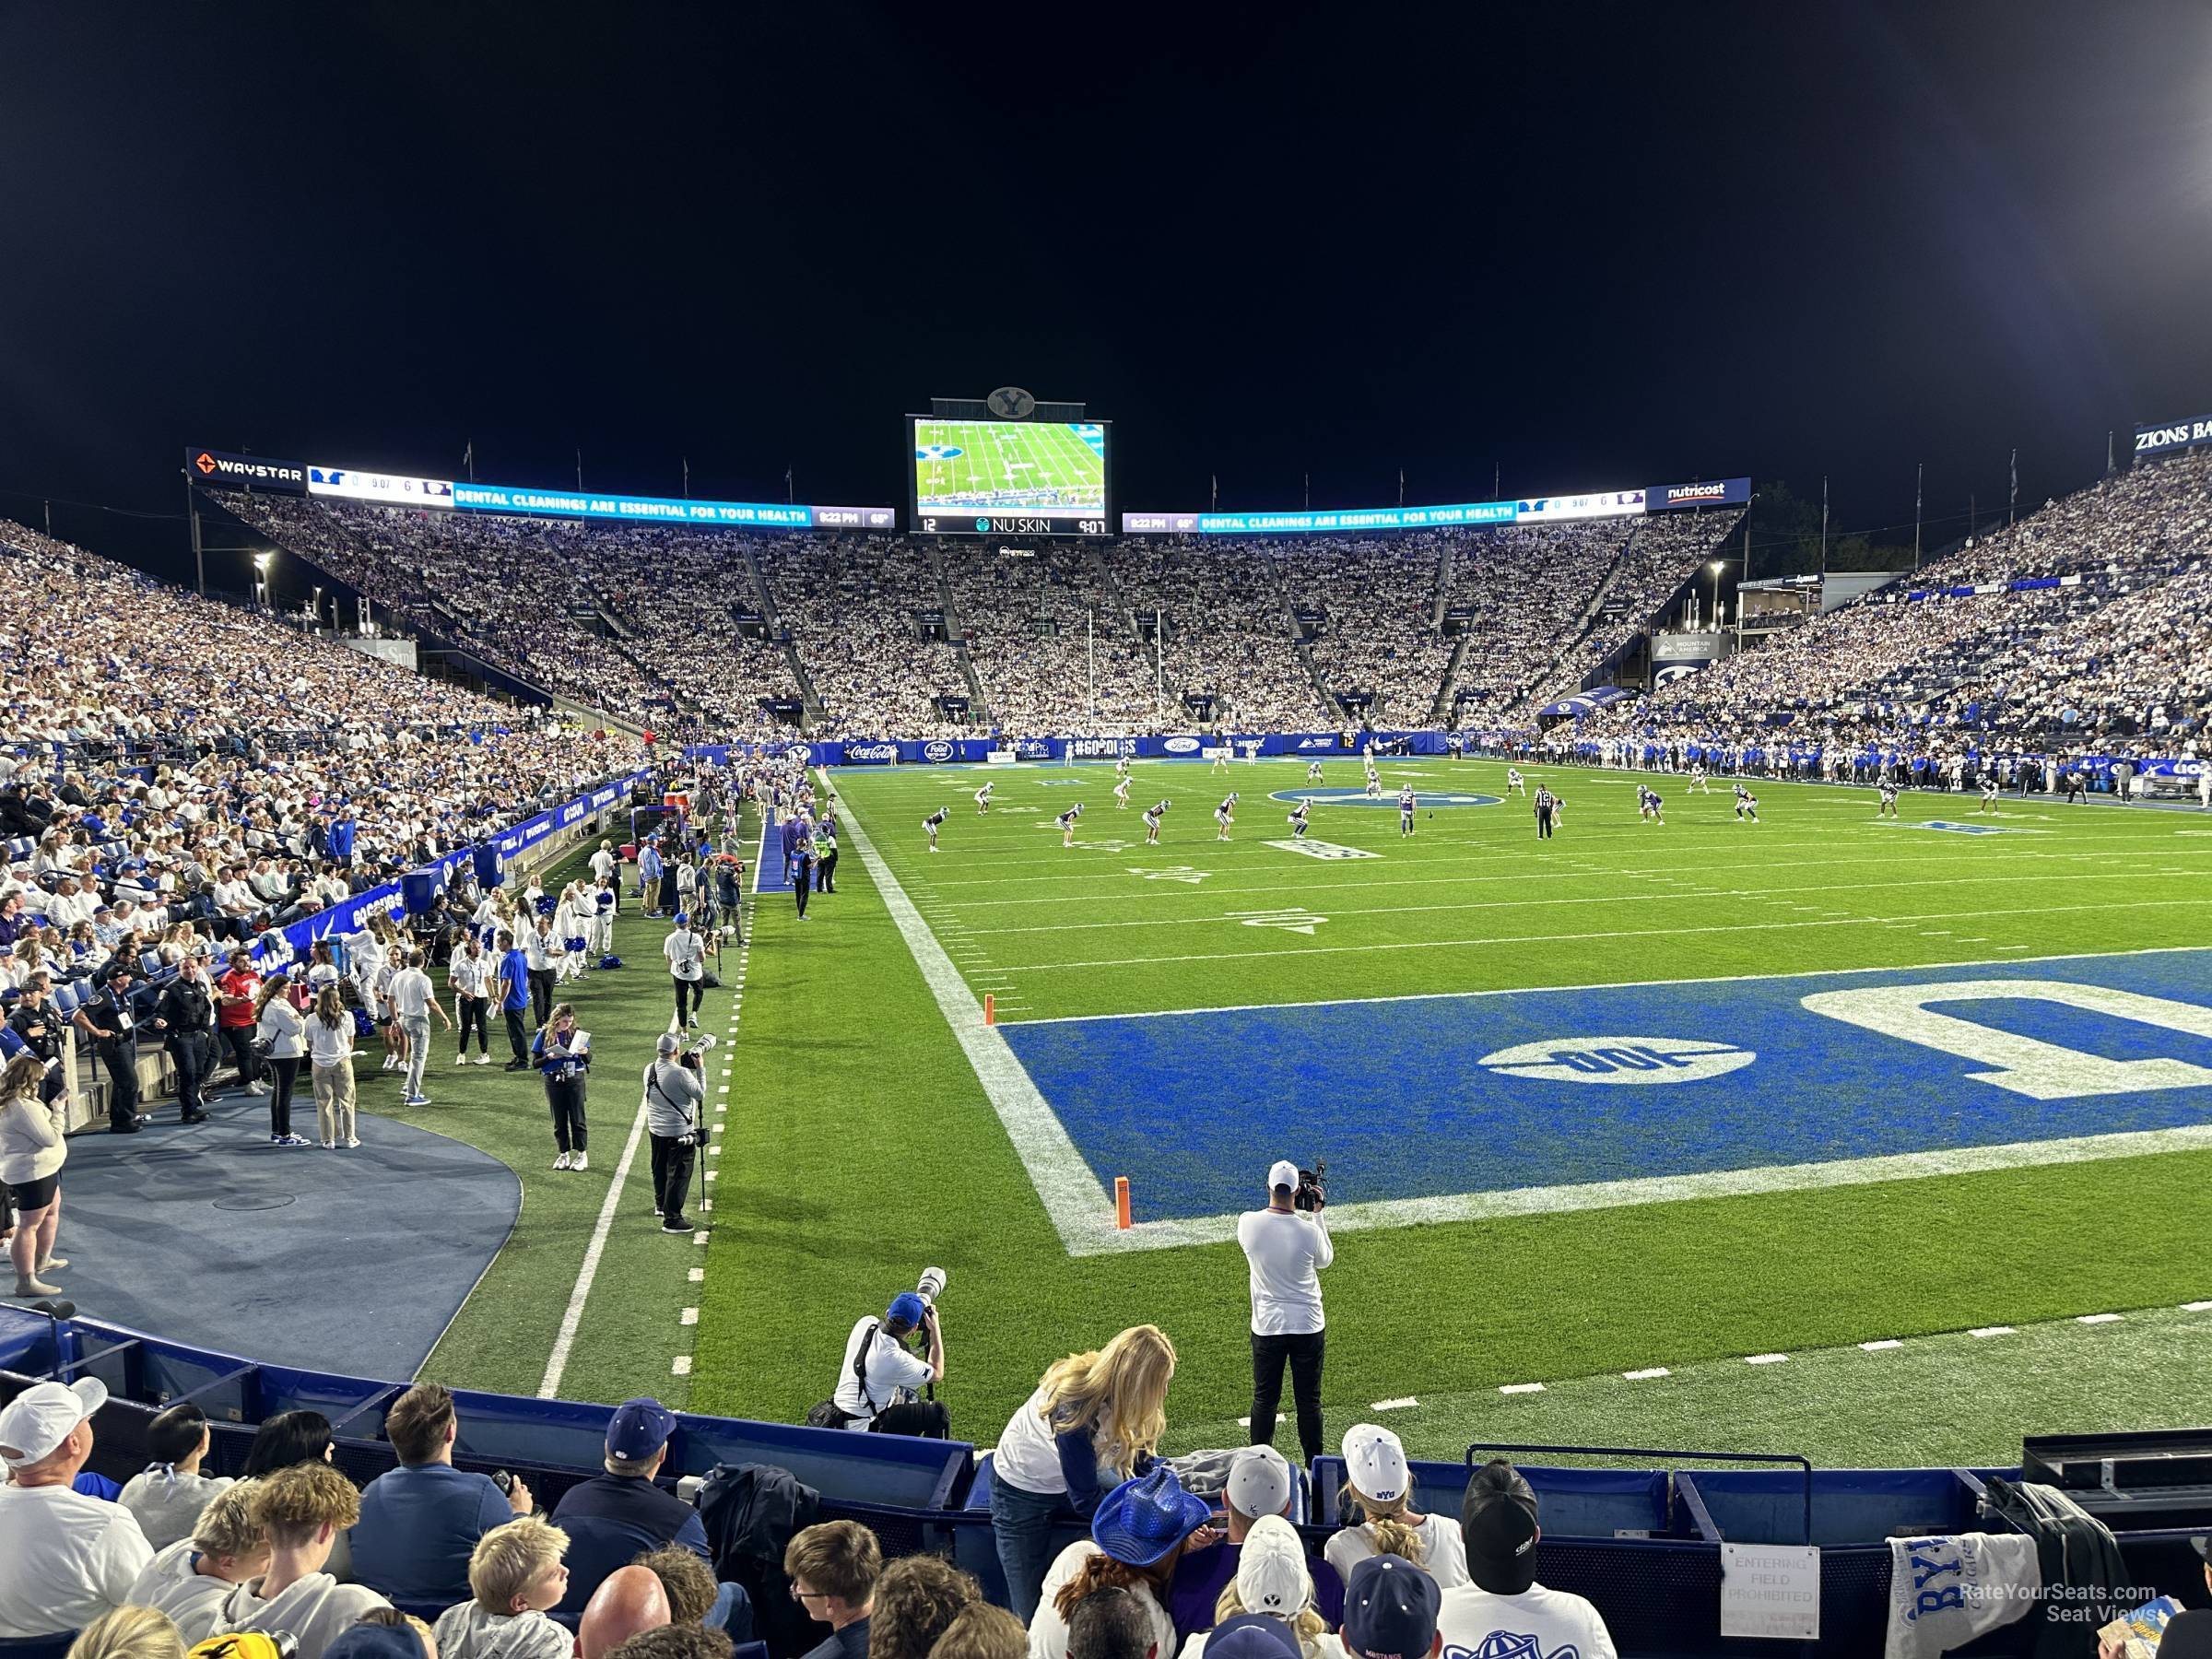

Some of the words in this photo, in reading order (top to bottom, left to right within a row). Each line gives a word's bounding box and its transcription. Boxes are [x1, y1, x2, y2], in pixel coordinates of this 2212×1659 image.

[2136, 425, 2189, 450] ZIONS
[217, 460, 302, 481] WAYSTAR
[1667, 482, 1724, 500] nutricost
[456, 489, 509, 505] DENTAL
[512, 494, 587, 511] CLEANINGS
[590, 500, 616, 512] ARE
[619, 502, 687, 517] ESSENTIAL
[690, 506, 716, 518] FOR
[719, 508, 755, 520] YOUR
[758, 510, 806, 522] HEALTH
[1201, 518, 1245, 528] DENTAL
[1248, 517, 1312, 528] CLEANINGS
[1315, 516, 1337, 526] ARE
[1340, 513, 1400, 525] ESSENTIAL
[1403, 512, 1427, 523] FOR
[1430, 510, 1463, 522] YOUR
[1465, 507, 1512, 520] HEALTH
[924, 518, 936, 532] 12
[993, 519, 1015, 532] NU
[1018, 519, 1051, 532] SKIN
[1079, 520, 1105, 534] 9:07
[1171, 740, 1192, 749] Ford
[1344, 737, 1355, 747] 12
[1400, 794, 1413, 805] 35
[1735, 1556, 1807, 1570] ENTERING
[1750, 1573, 1791, 1585] FIELD
[1728, 1588, 1813, 1602] PROHIBITED
